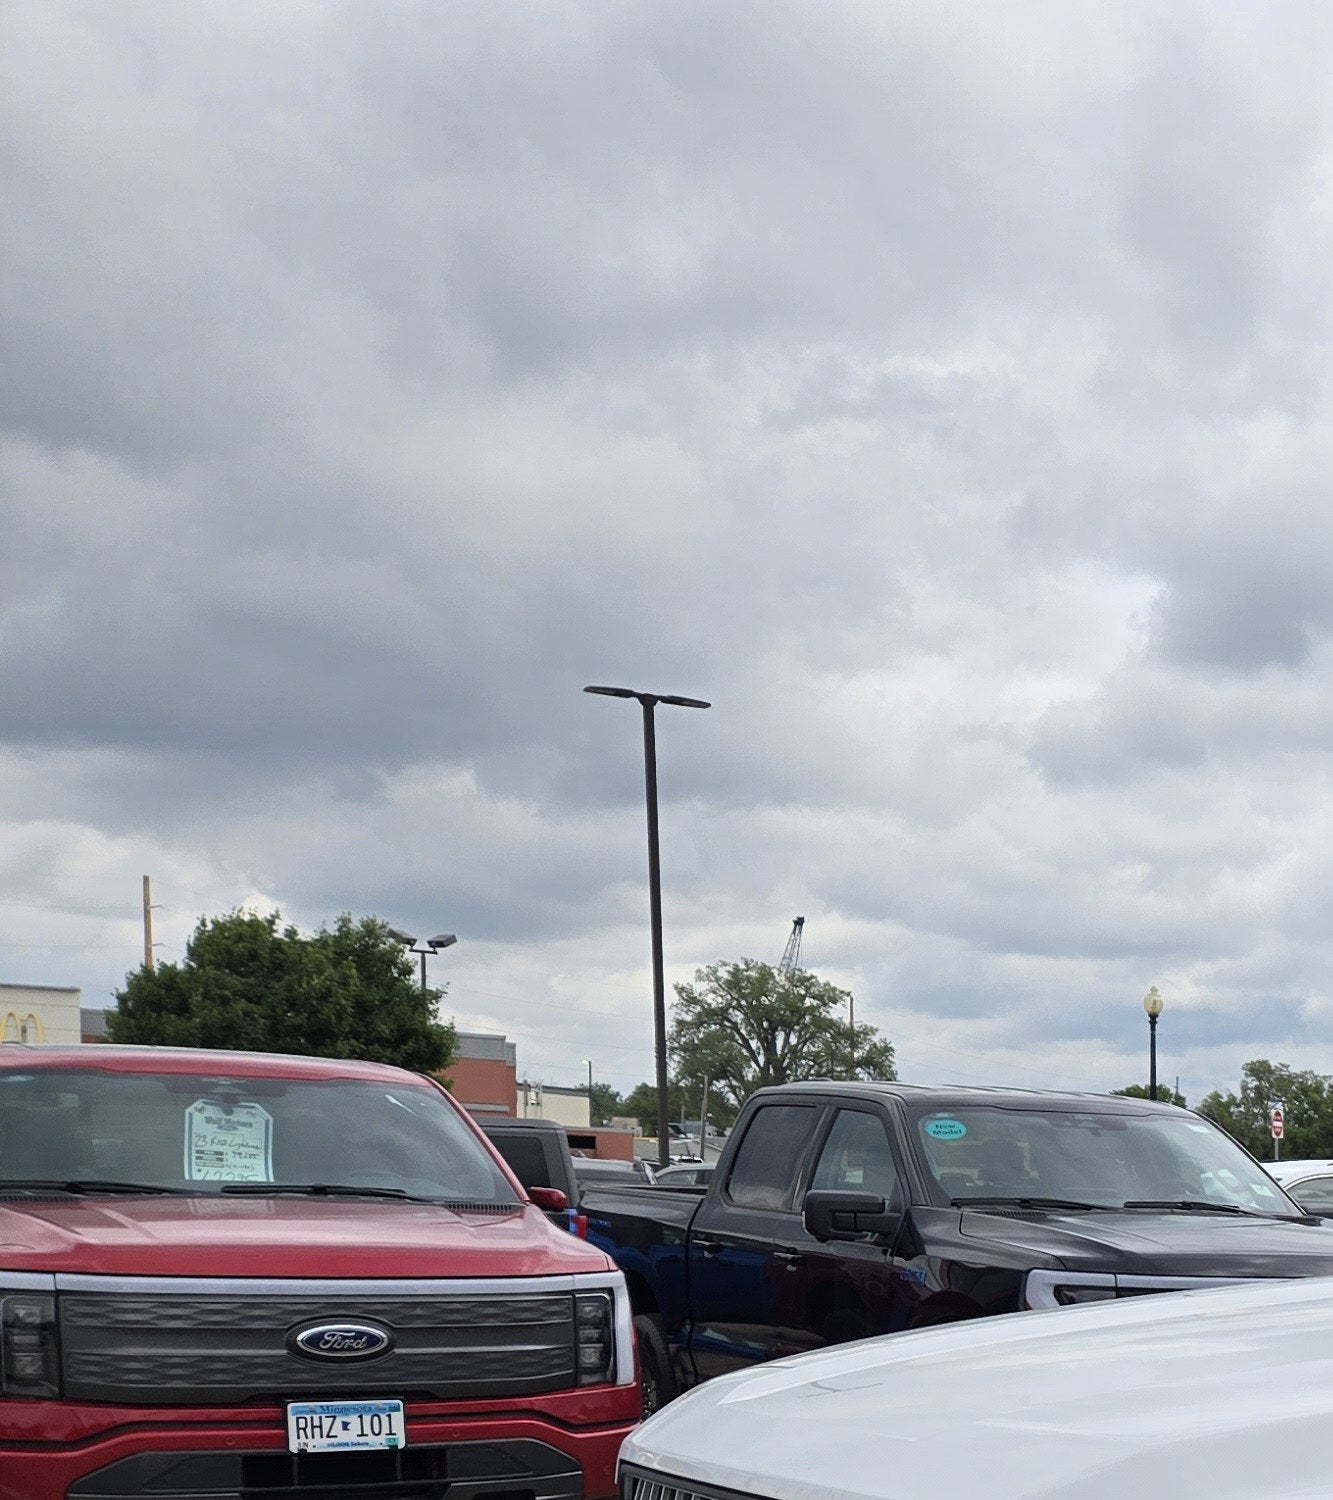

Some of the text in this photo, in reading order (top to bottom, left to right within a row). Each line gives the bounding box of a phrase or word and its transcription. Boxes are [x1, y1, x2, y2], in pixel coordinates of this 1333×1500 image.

[320, 1331, 367, 1349] Ford
[320, 1405, 373, 1413] Minnesota
[296, 1413, 397, 1440] RHZ 101
